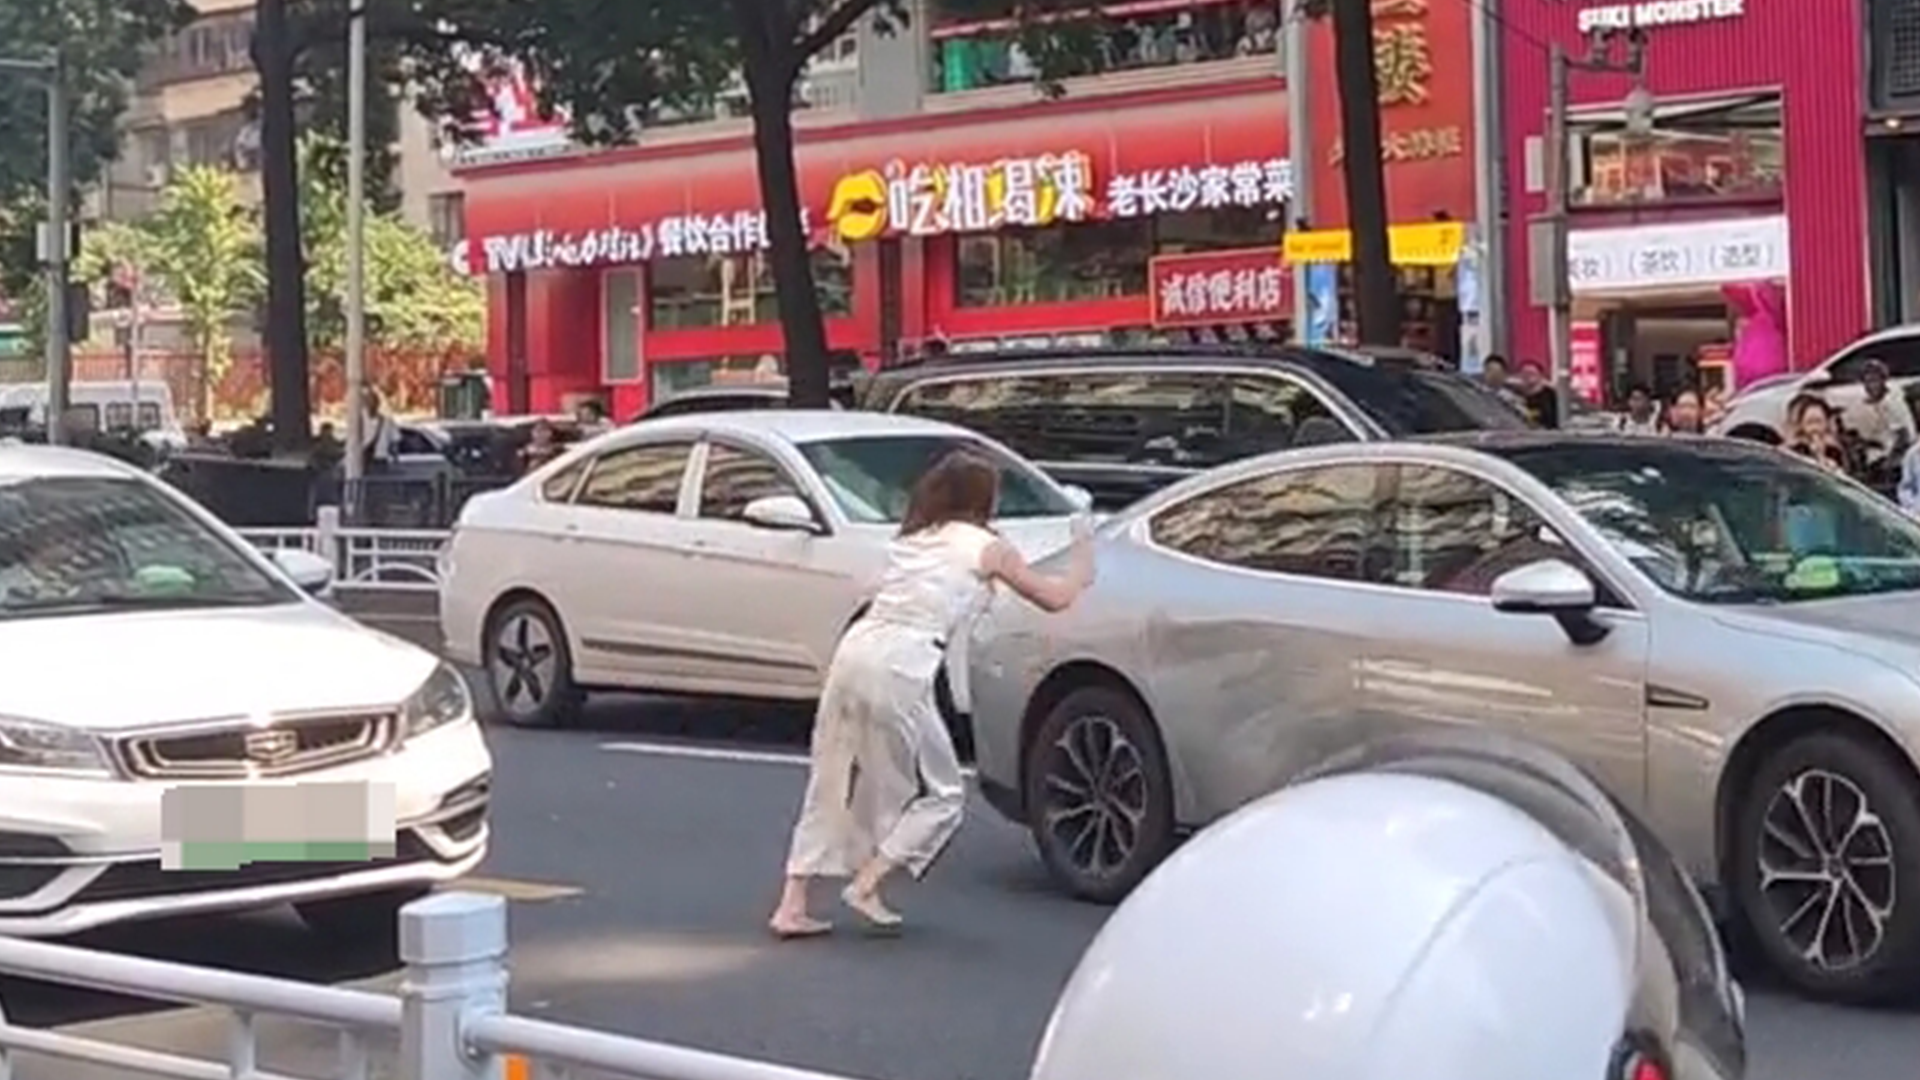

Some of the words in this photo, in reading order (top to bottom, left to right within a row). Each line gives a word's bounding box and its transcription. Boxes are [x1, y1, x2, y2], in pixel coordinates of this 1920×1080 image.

[1578, 5, 1630, 32] SUKI
[1635, 0, 1744, 26] MONSTER
[1107, 158, 1294, 216] 老长沙家常菜
